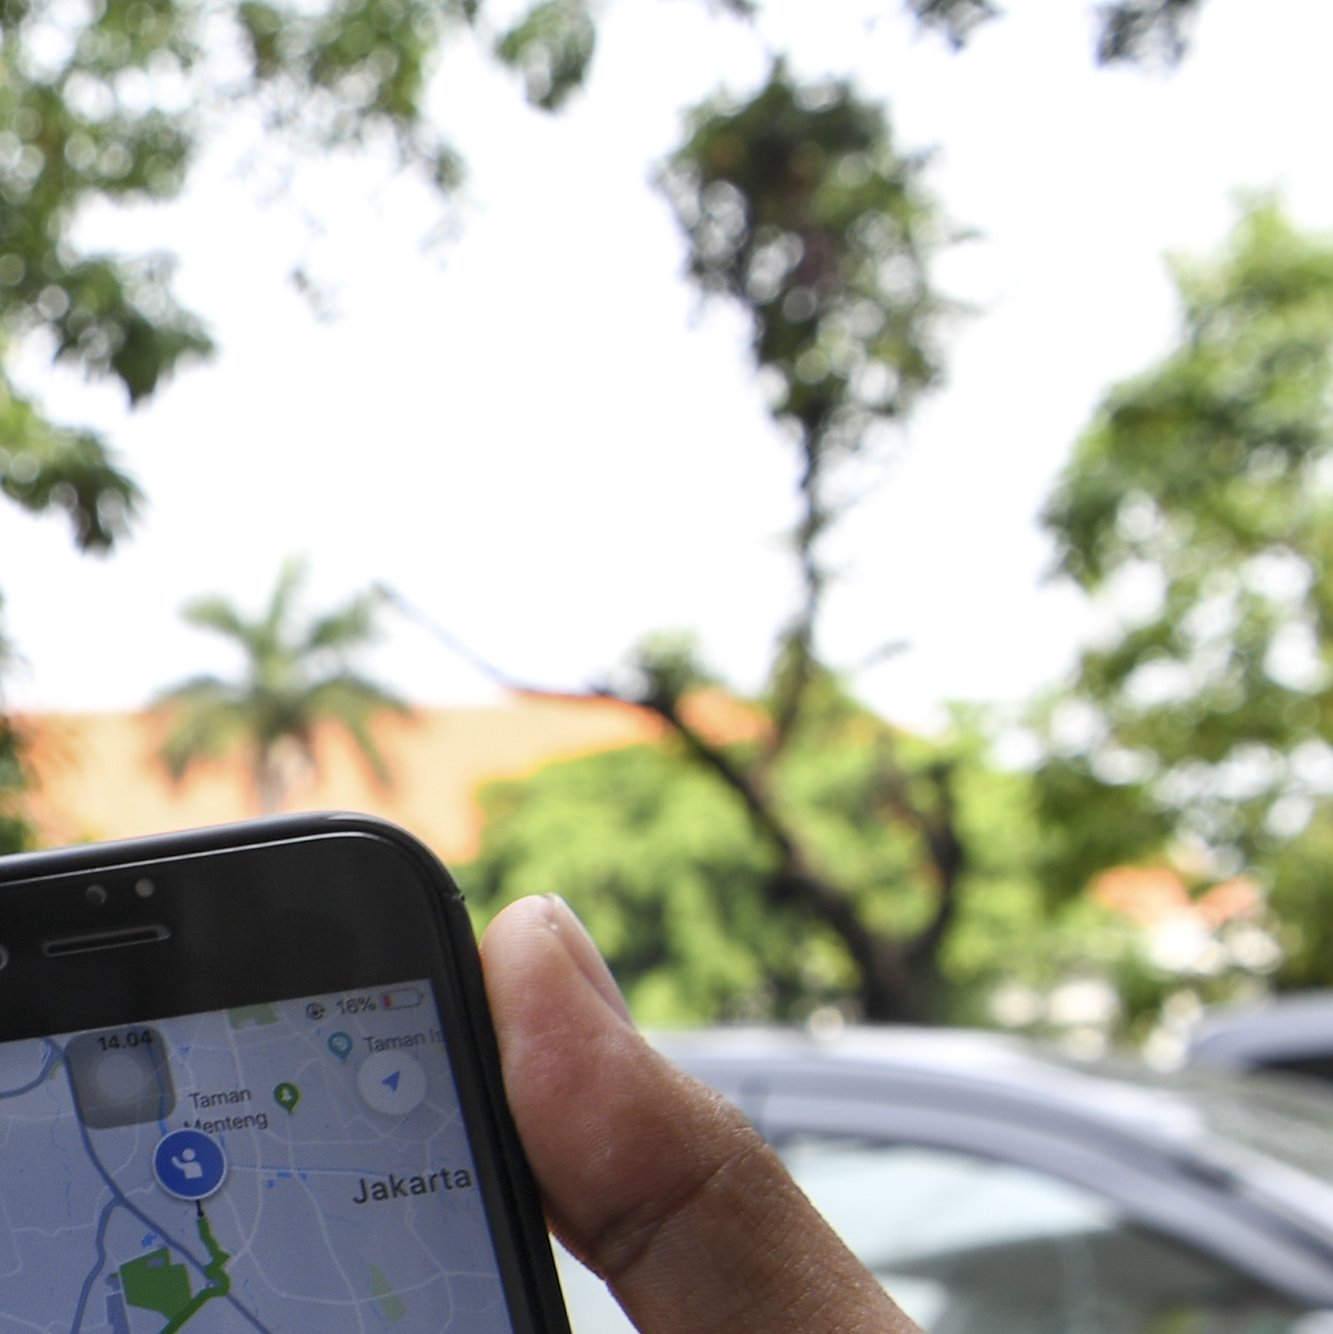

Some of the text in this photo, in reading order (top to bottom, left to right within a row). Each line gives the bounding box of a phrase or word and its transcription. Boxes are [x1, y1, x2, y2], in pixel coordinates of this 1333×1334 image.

[336, 996, 377, 1016] 16%
[97, 1029, 154, 1051] 14.04
[362, 1031, 426, 1052] Taman
[189, 1087, 252, 1110] Taman
[183, 1111, 269, 1135] Menteng
[352, 1167, 473, 1205] Jakarta
